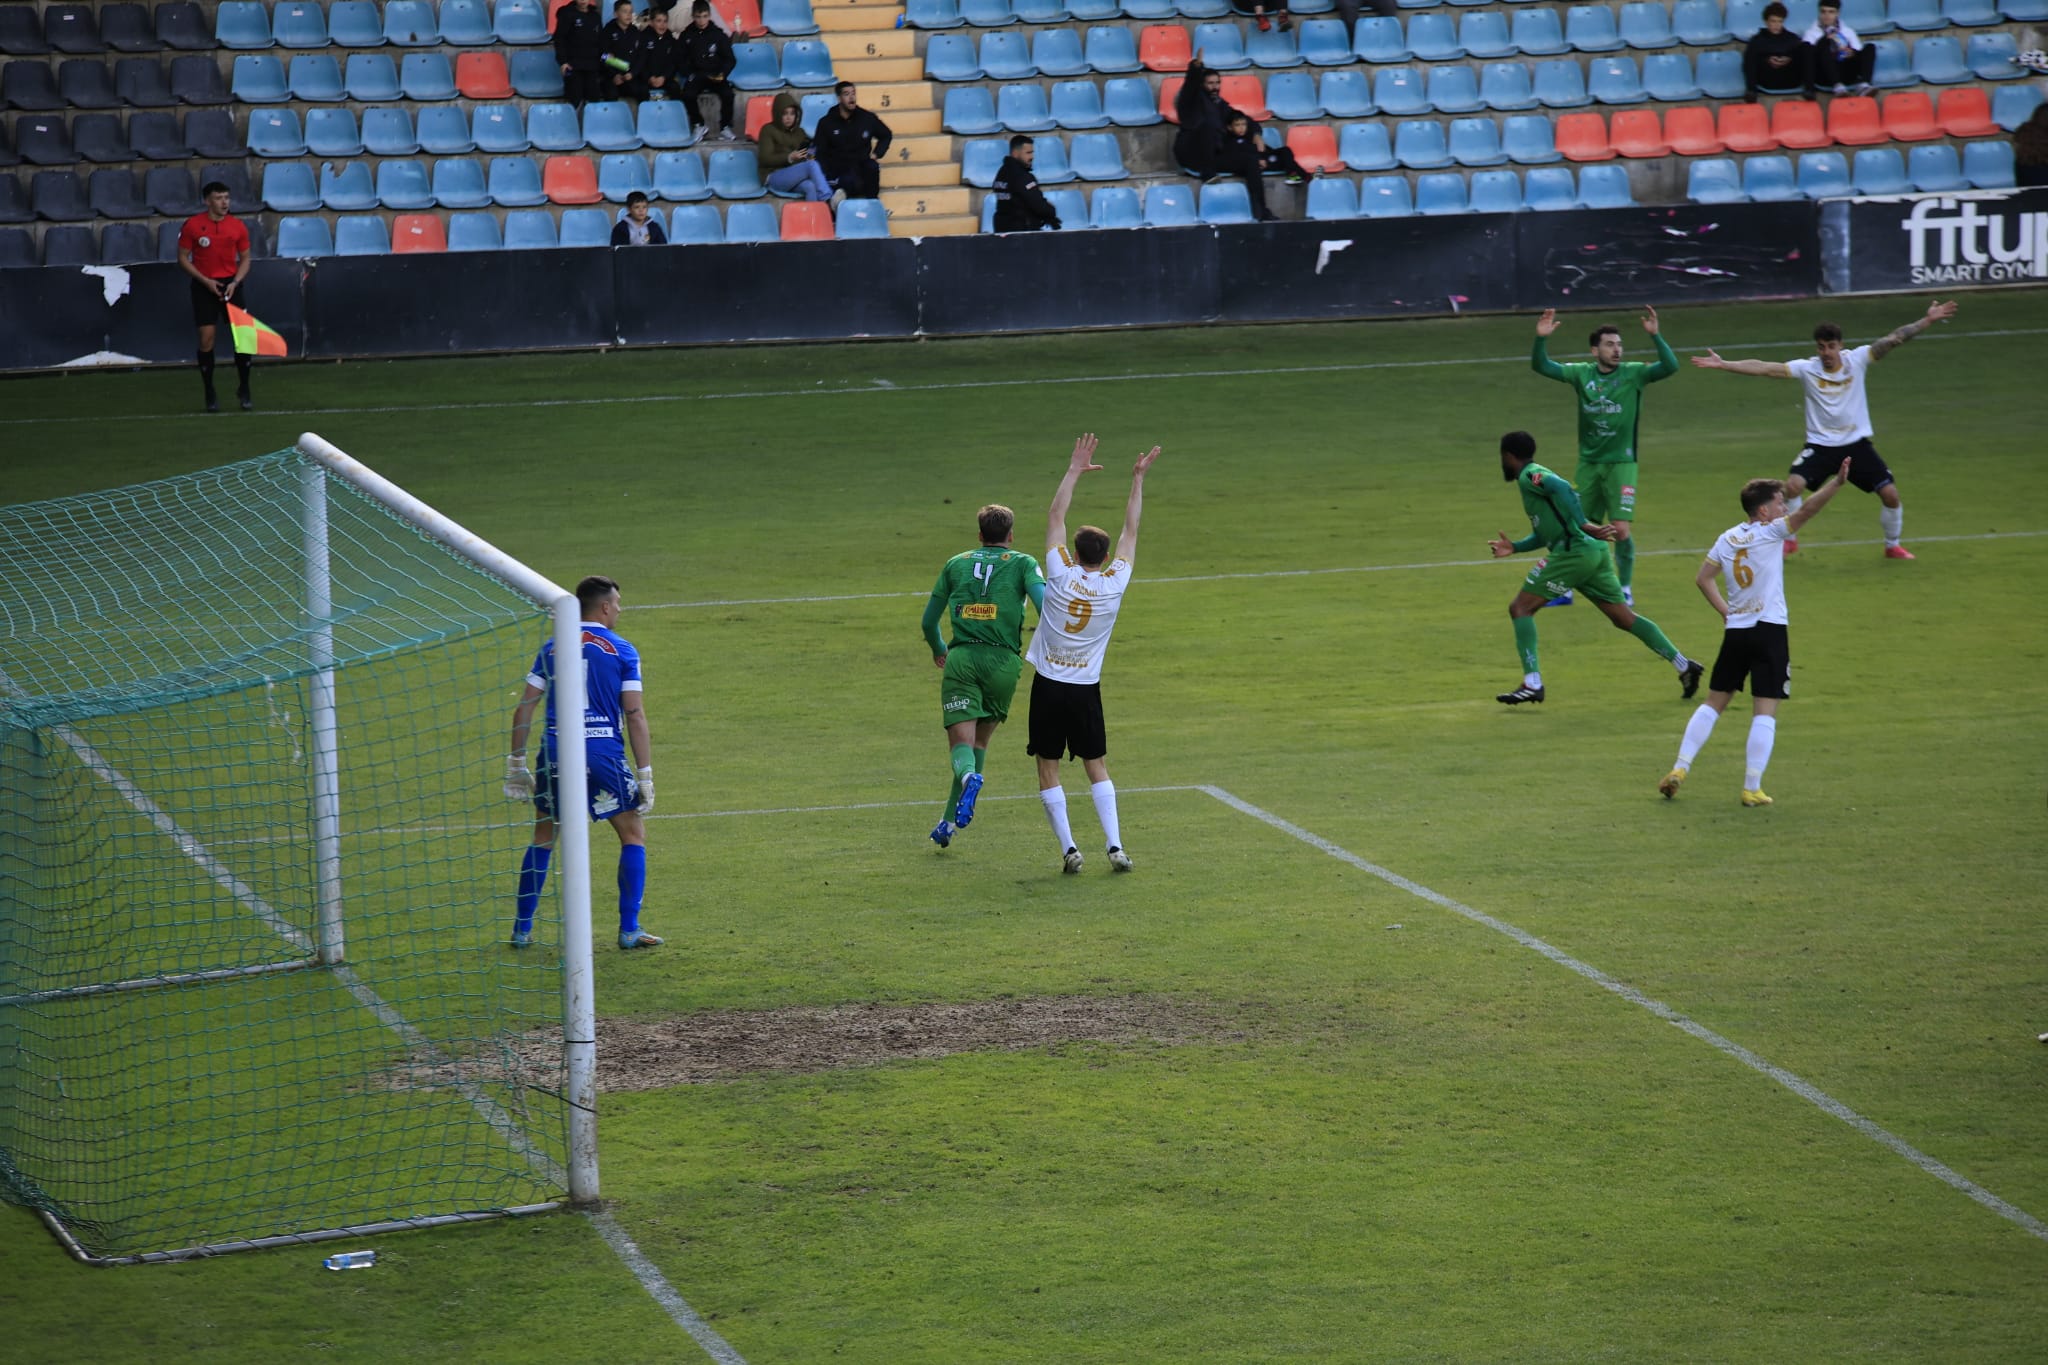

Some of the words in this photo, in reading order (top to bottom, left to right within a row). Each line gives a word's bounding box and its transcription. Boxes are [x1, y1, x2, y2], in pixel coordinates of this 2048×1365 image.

[866, 43, 876, 55] 6
[1911, 263, 1985, 284] SMART
[1988, 261, 2033, 280] GYM
[973, 561, 994, 597] 4
[1733, 548, 1754, 589] 6
[1064, 597, 1092, 634] 9
